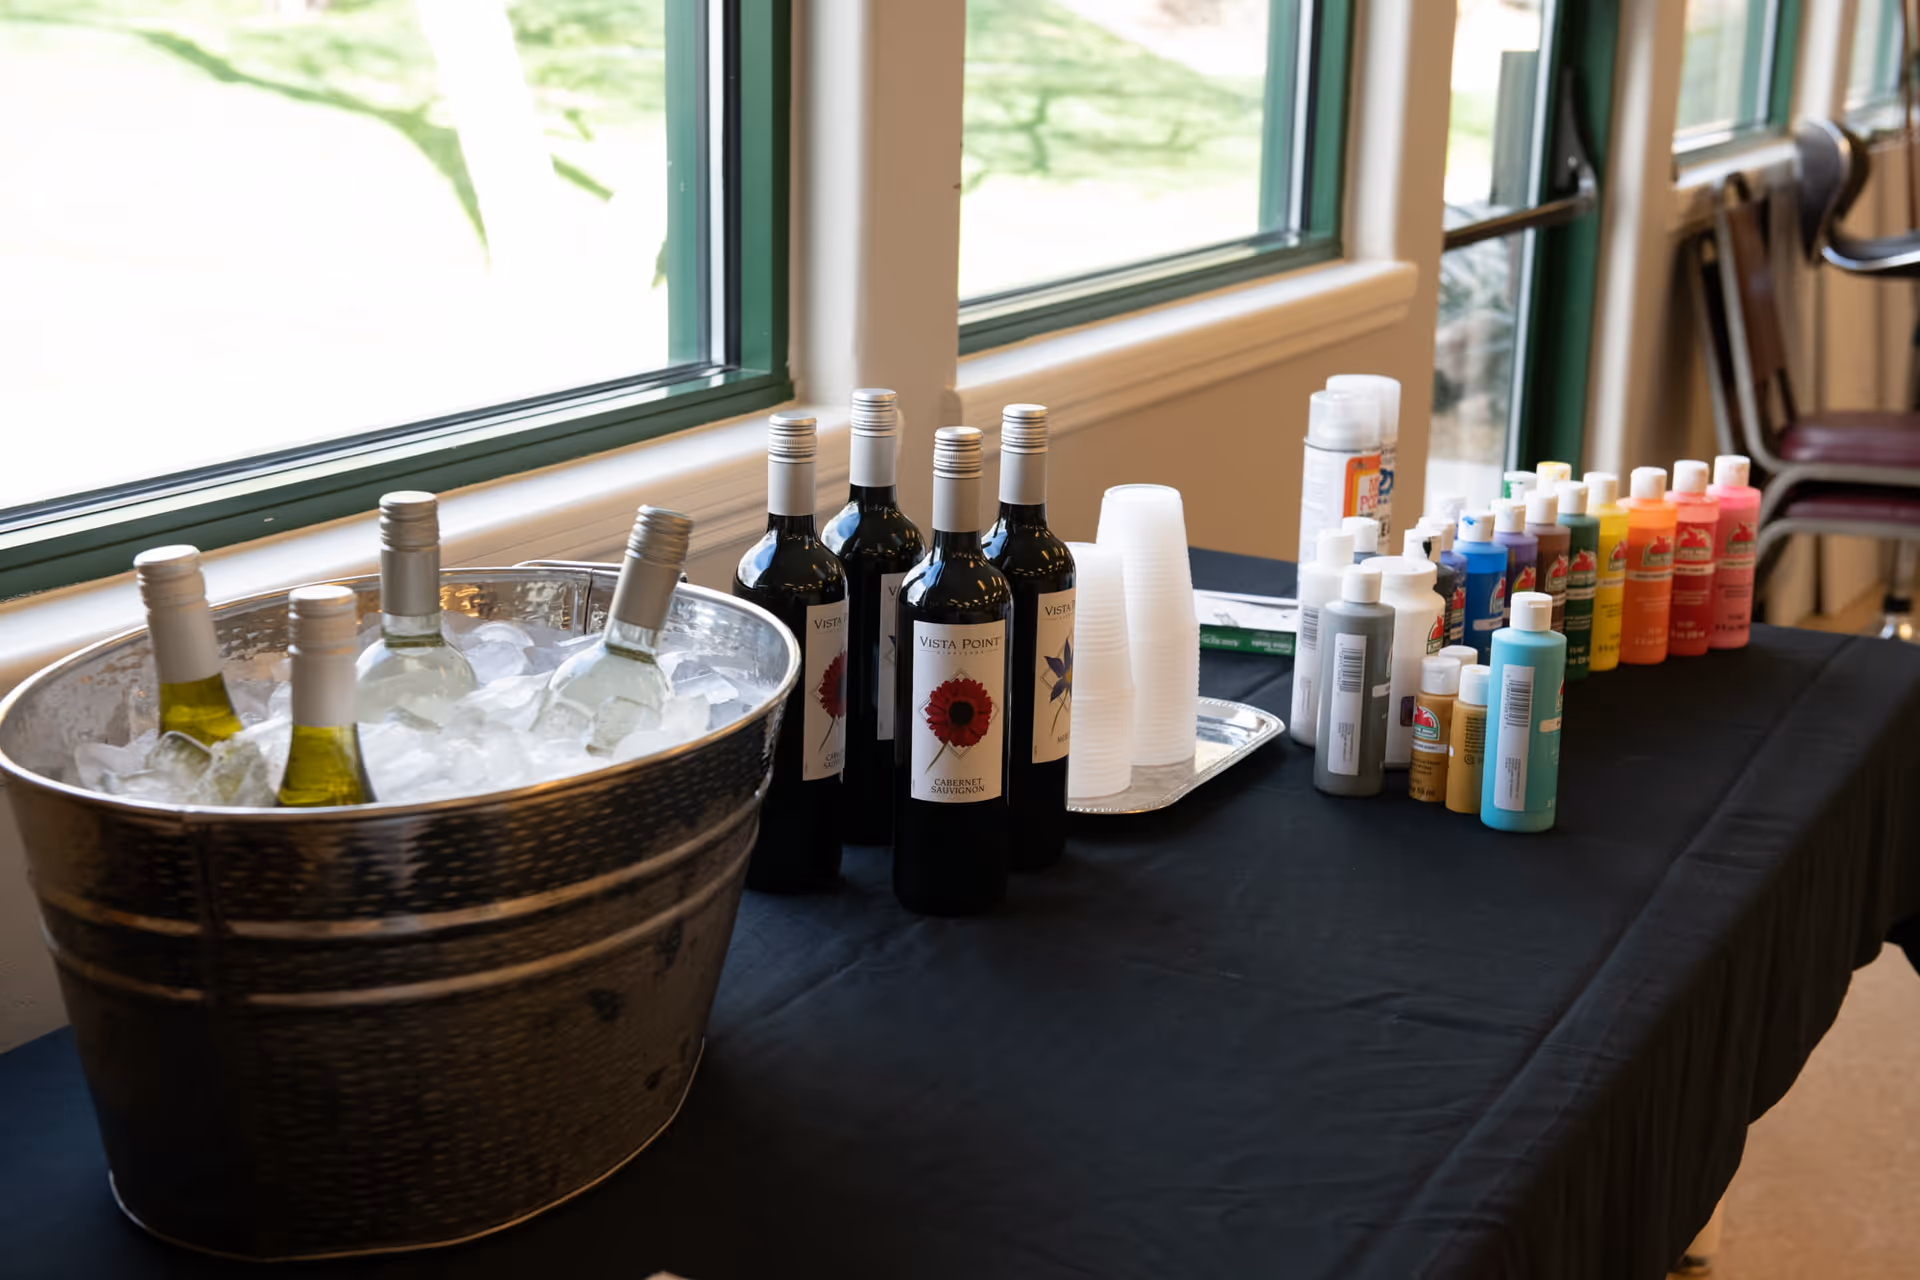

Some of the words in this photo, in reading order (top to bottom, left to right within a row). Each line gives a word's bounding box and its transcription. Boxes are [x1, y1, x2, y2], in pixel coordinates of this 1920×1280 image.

[1045, 604, 1071, 616] VISTA
[814, 617, 842, 630] VISTA
[920, 636, 956, 649] VISTA
[962, 636, 1001, 649] POINT
[934, 778, 982, 786] CABERNET
[931, 786, 984, 794] SAUVIGNON
